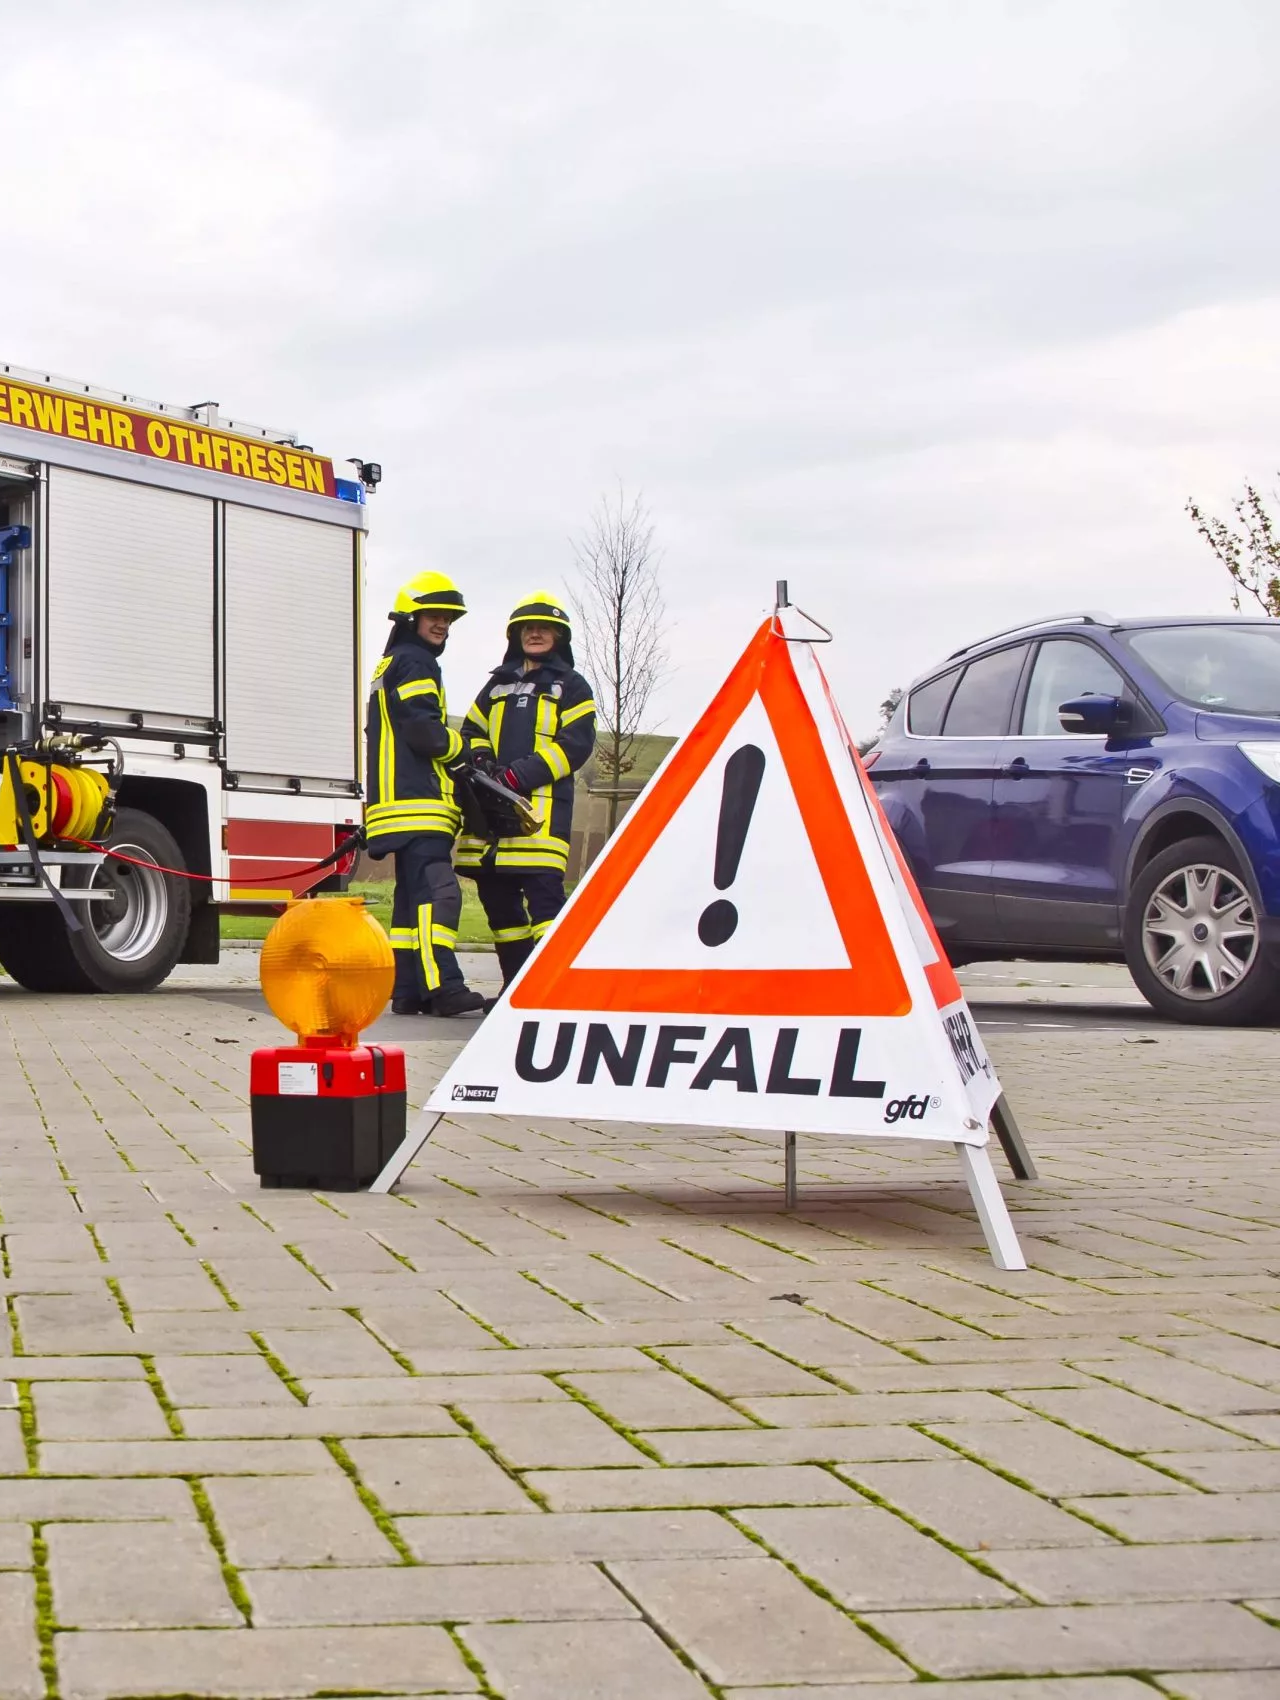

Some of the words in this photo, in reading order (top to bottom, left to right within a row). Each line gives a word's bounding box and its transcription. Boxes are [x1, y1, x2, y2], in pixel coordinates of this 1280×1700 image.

[147, 420, 326, 494] OTHFRESEN
[467, 1089, 496, 1098] NESTLE
[514, 1020, 886, 1099] UNFALL
